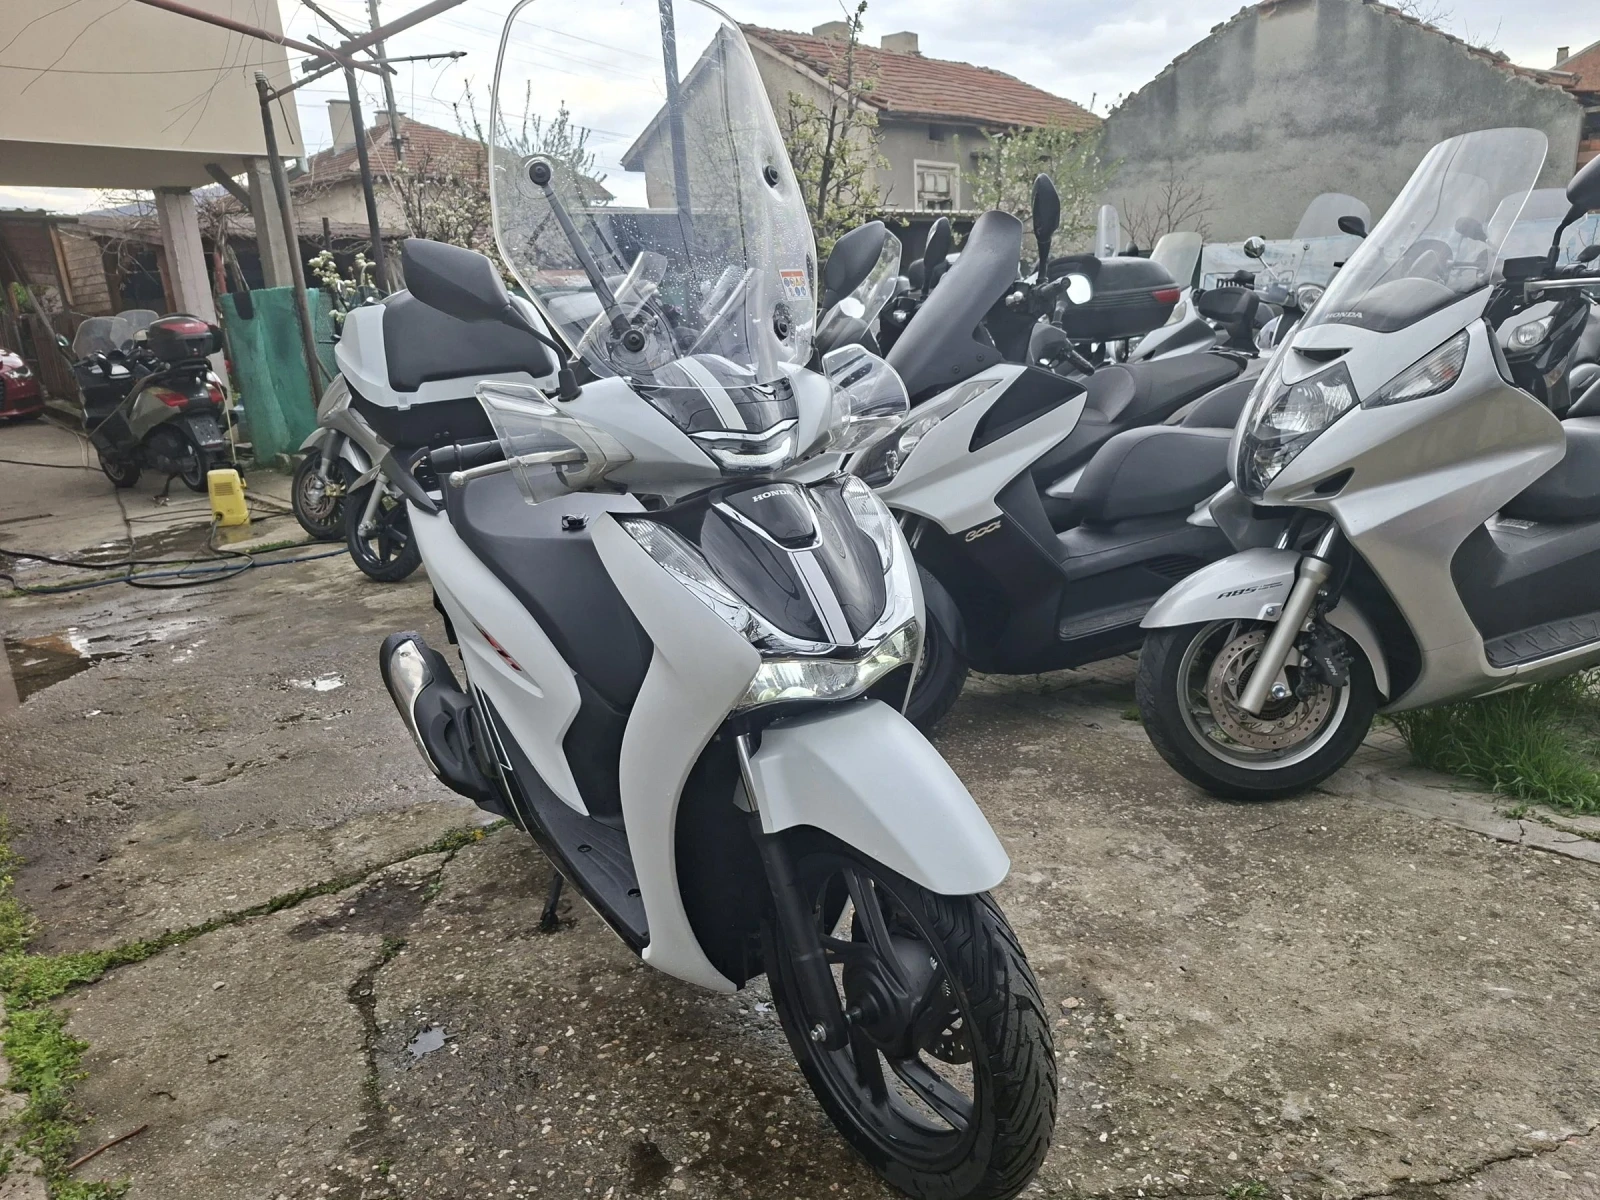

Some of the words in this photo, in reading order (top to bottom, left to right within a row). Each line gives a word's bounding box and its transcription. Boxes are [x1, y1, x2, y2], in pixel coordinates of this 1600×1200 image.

[1325, 311, 1363, 319] HONDA
[752, 489, 793, 502] HONDA
[1216, 586, 1258, 600] ABS
